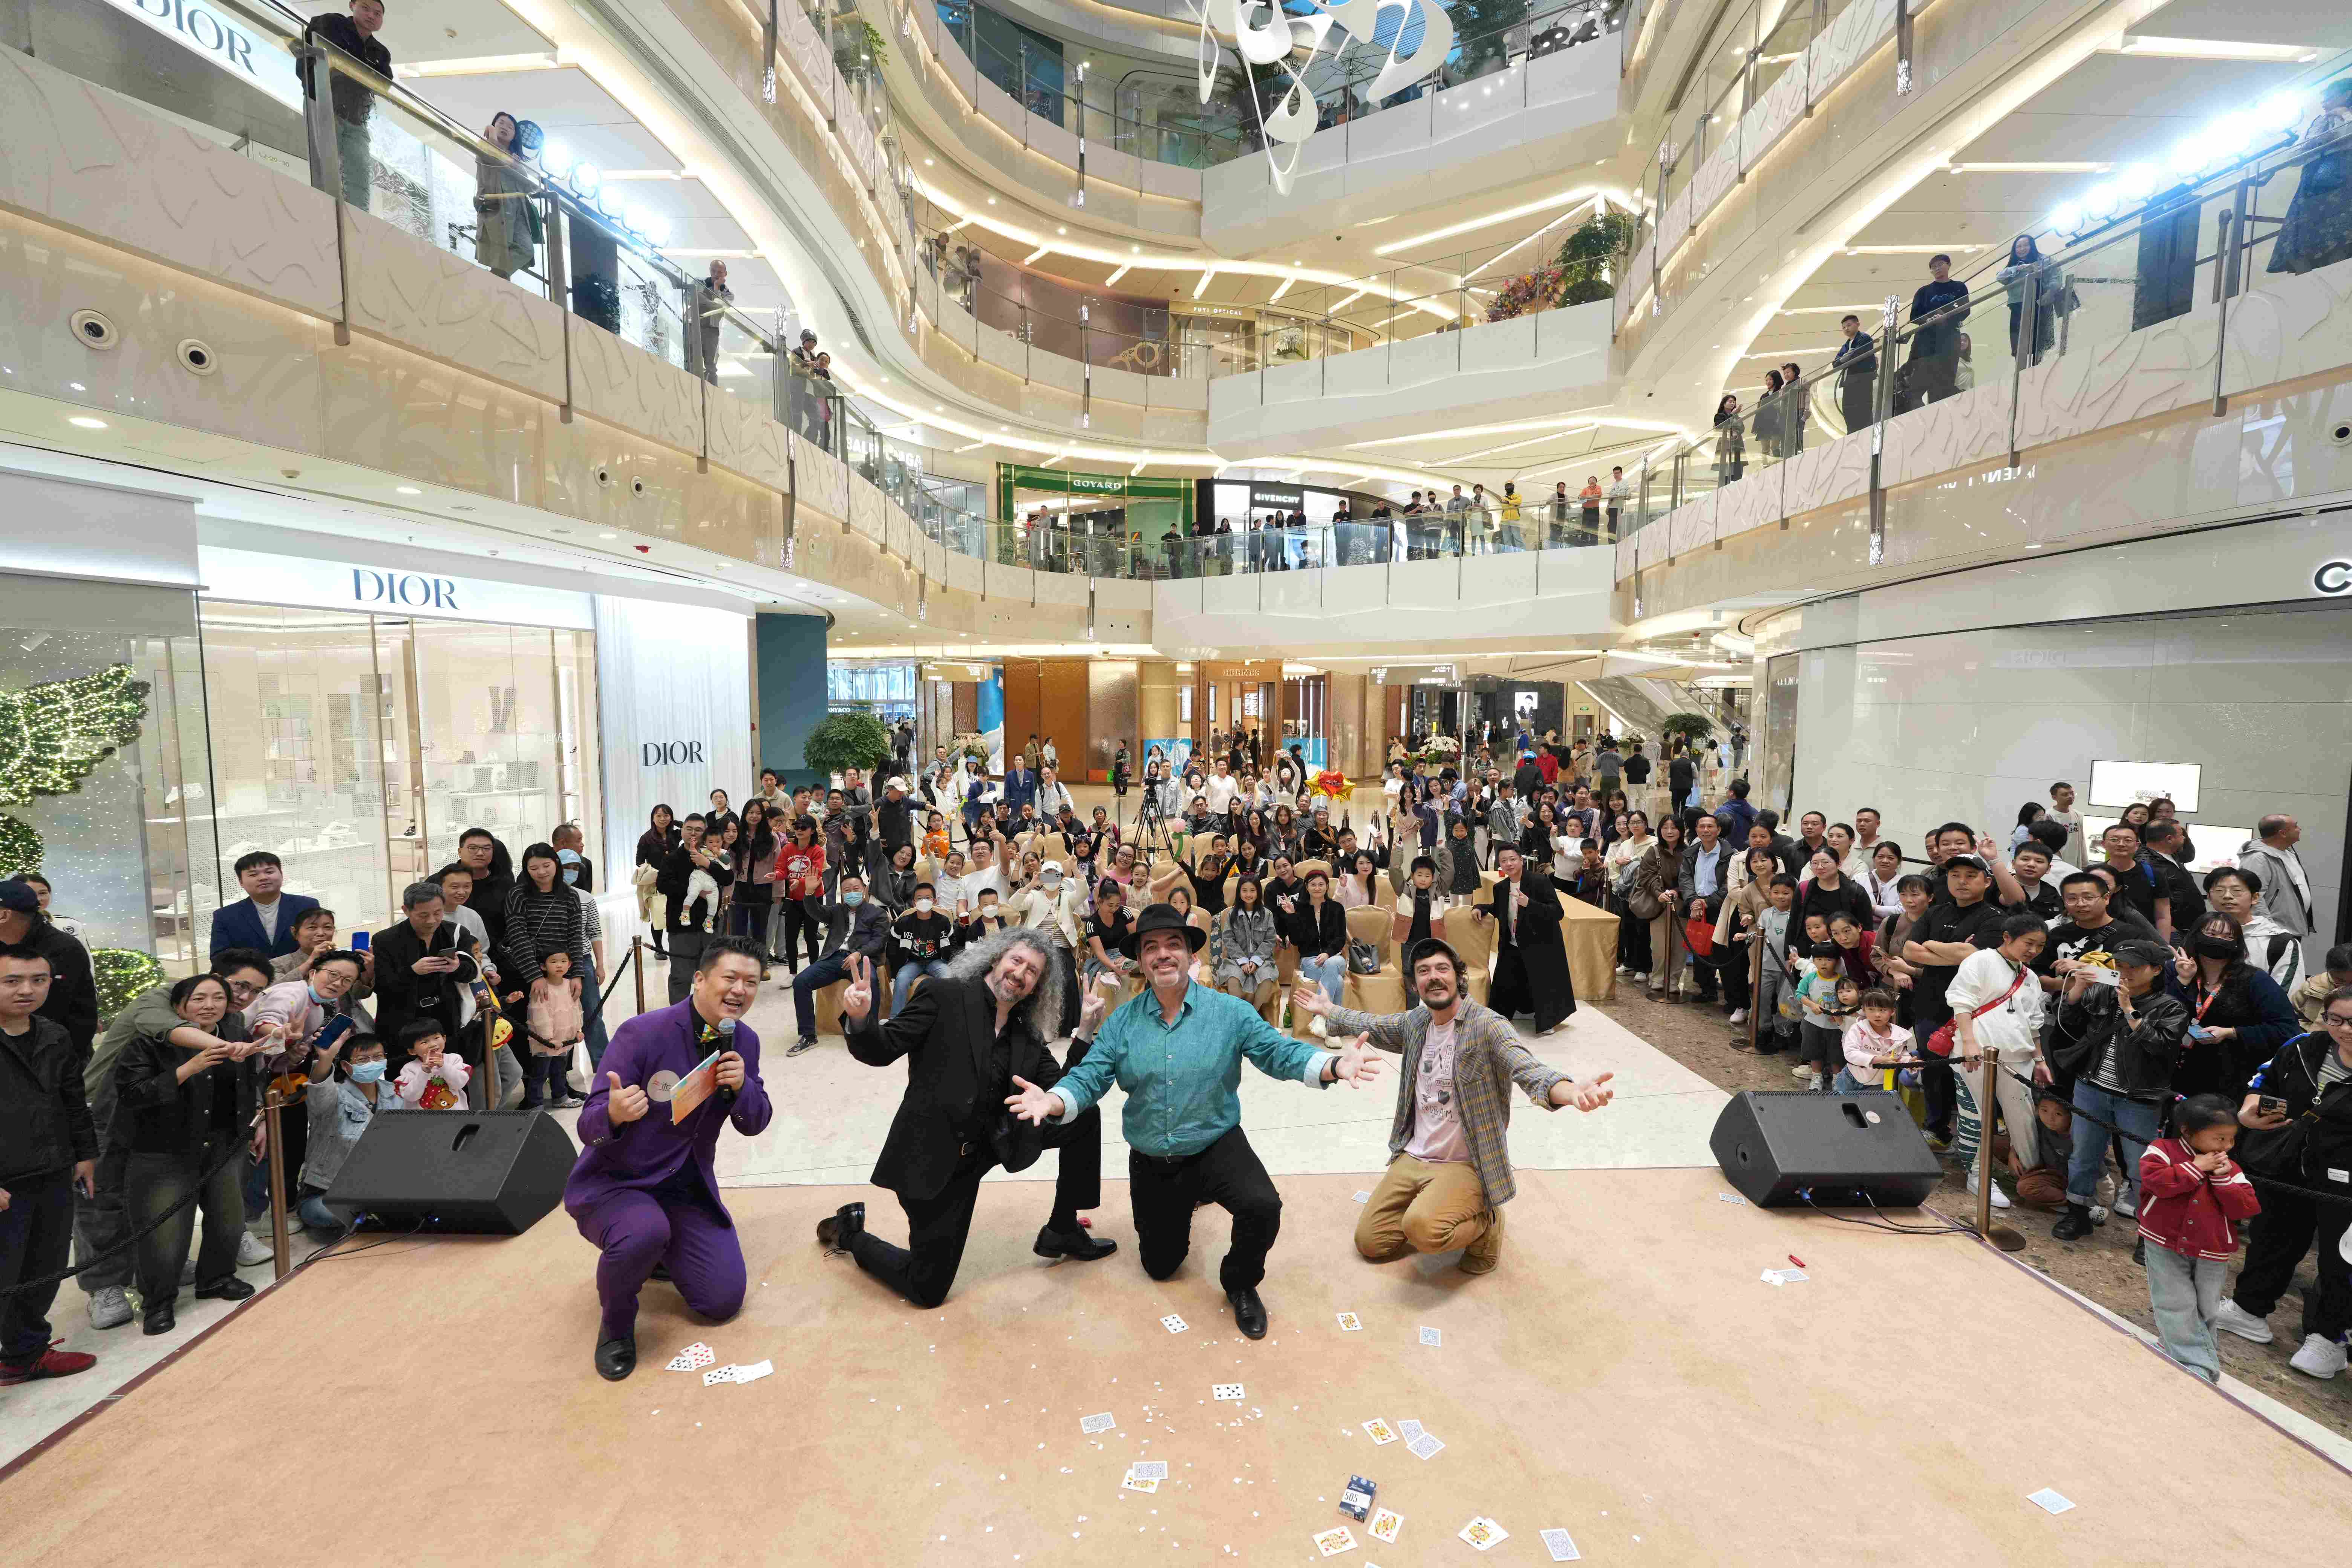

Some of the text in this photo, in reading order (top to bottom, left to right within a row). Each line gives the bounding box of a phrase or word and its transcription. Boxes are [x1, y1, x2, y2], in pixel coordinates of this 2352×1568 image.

[1073, 480, 1122, 490] GOYARD
[1254, 493, 1300, 503] GIVENCHY
[350, 568, 460, 610] DIOR
[642, 741, 704, 766] DIOR
[1344, 1491, 1357, 1502] 505
